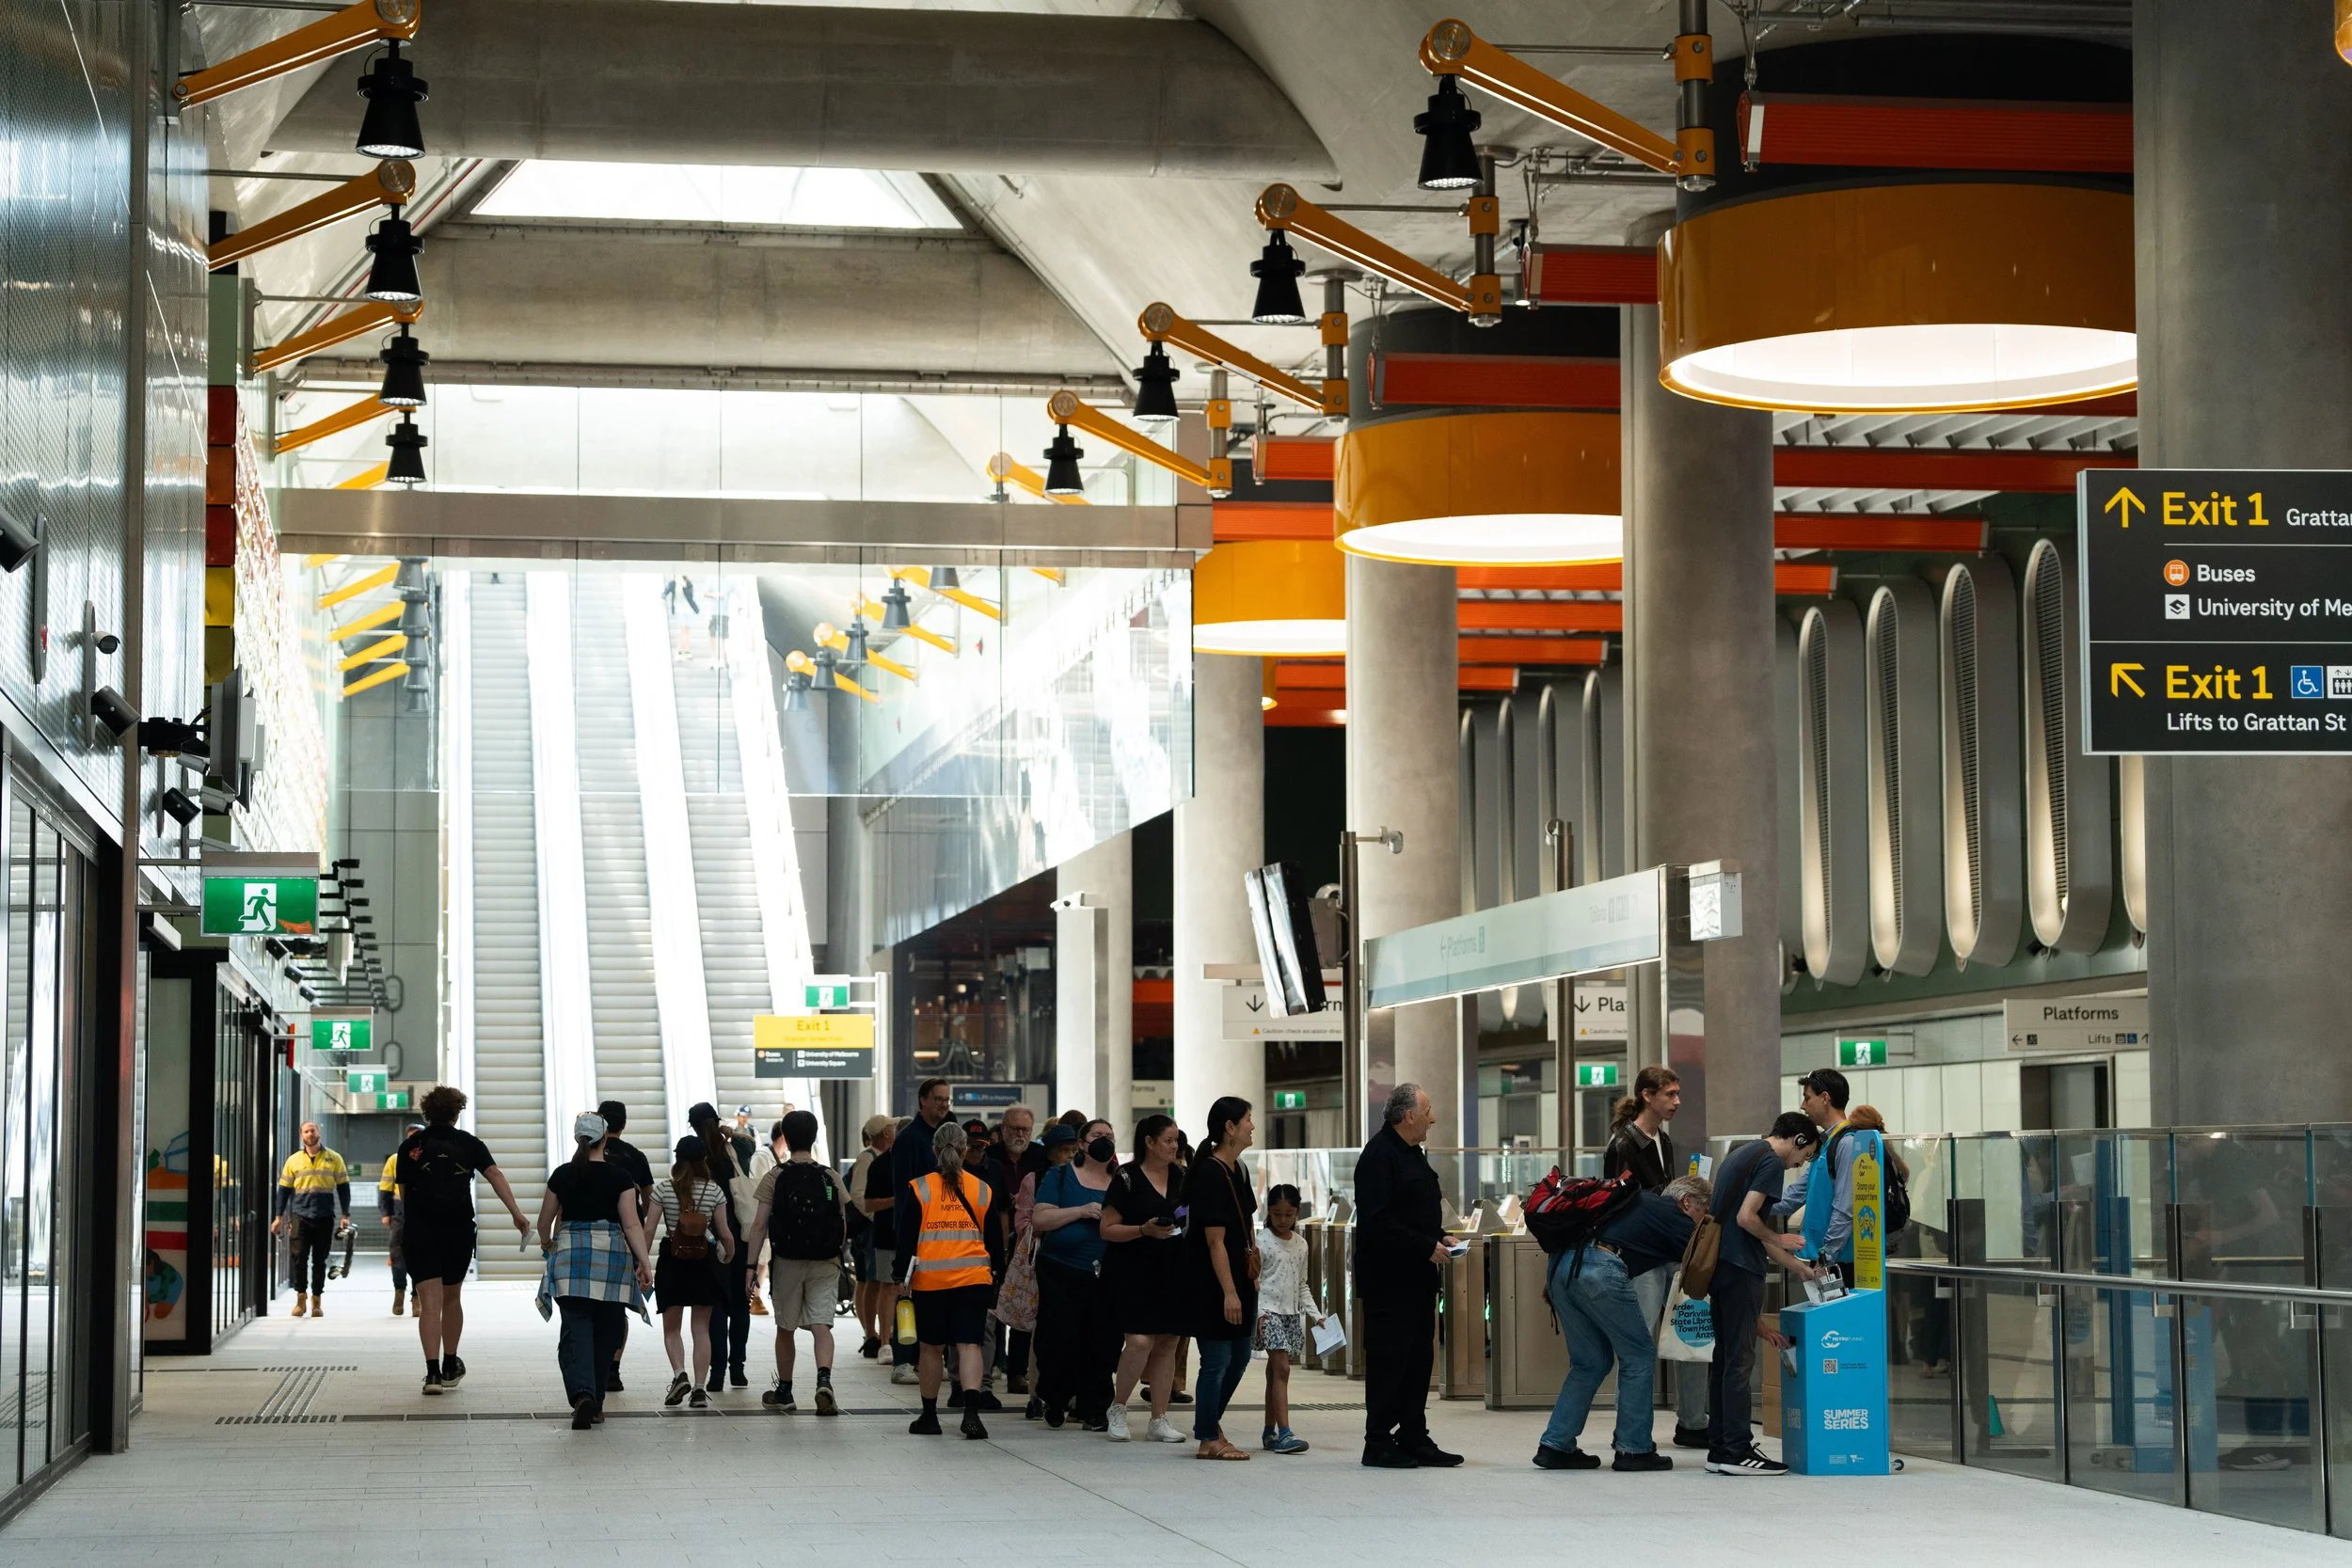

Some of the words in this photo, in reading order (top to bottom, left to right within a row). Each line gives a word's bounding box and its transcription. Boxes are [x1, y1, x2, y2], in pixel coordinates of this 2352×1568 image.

[2163, 491, 2237, 526] Exit
[2248, 492, 2269, 526] 1
[2286, 508, 2352, 527] Gratta
[2197, 564, 2256, 582] Buses
[2198, 598, 2294, 621] University
[2299, 598, 2320, 616] of
[2167, 665, 2242, 700] Exit
[2252, 666, 2273, 699] 1
[2168, 713, 2212, 731] Lifts
[2219, 716, 2238, 731] to
[2244, 713, 2319, 731] Grattan
[2325, 713, 2346, 731] St
[1598, 997, 1627, 1012] Pla
[2043, 1006, 2119, 1021] Platforms
[797, 1020, 820, 1031] Exit
[824, 1021, 830, 1031] 1
[2088, 1035, 2111, 1044] Lifts
[927, 1221, 958, 1229] CUSTOMER
[1823, 1409, 1868, 1419] SUMMER
[1823, 1417, 1869, 1430] SERIES
